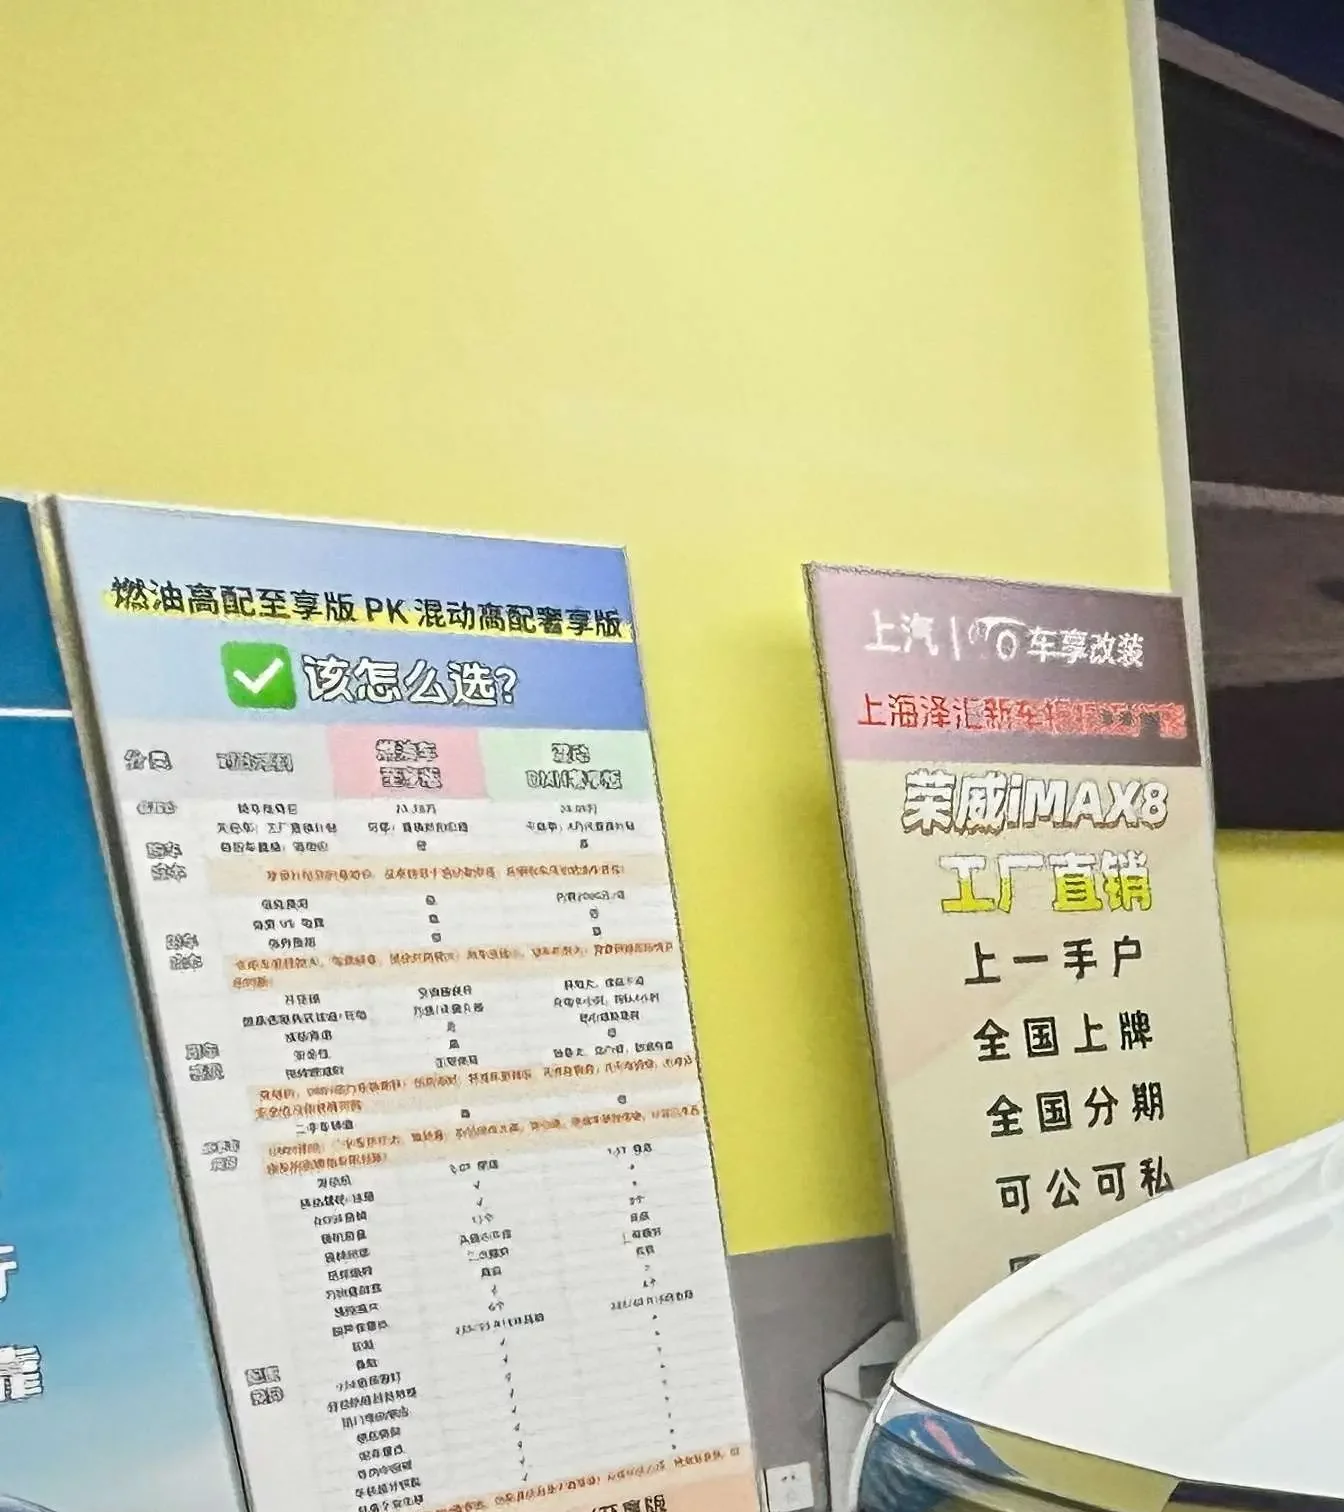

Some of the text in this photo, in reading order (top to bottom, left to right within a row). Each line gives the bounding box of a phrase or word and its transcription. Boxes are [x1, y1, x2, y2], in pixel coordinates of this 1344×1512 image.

[112, 576, 356, 623] 燃油高配至享版
[366, 599, 408, 624] PK
[865, 609, 1144, 669] 上汽 车享改装
[901, 768, 1169, 835] 荣威iMAX8
[939, 850, 1151, 913] 工厂直销
[964, 935, 1142, 985] 上一手户
[973, 1010, 1152, 1061] 全国上牌
[987, 1082, 1164, 1137] 全国分期
[995, 1156, 1174, 1214] 可公可私
